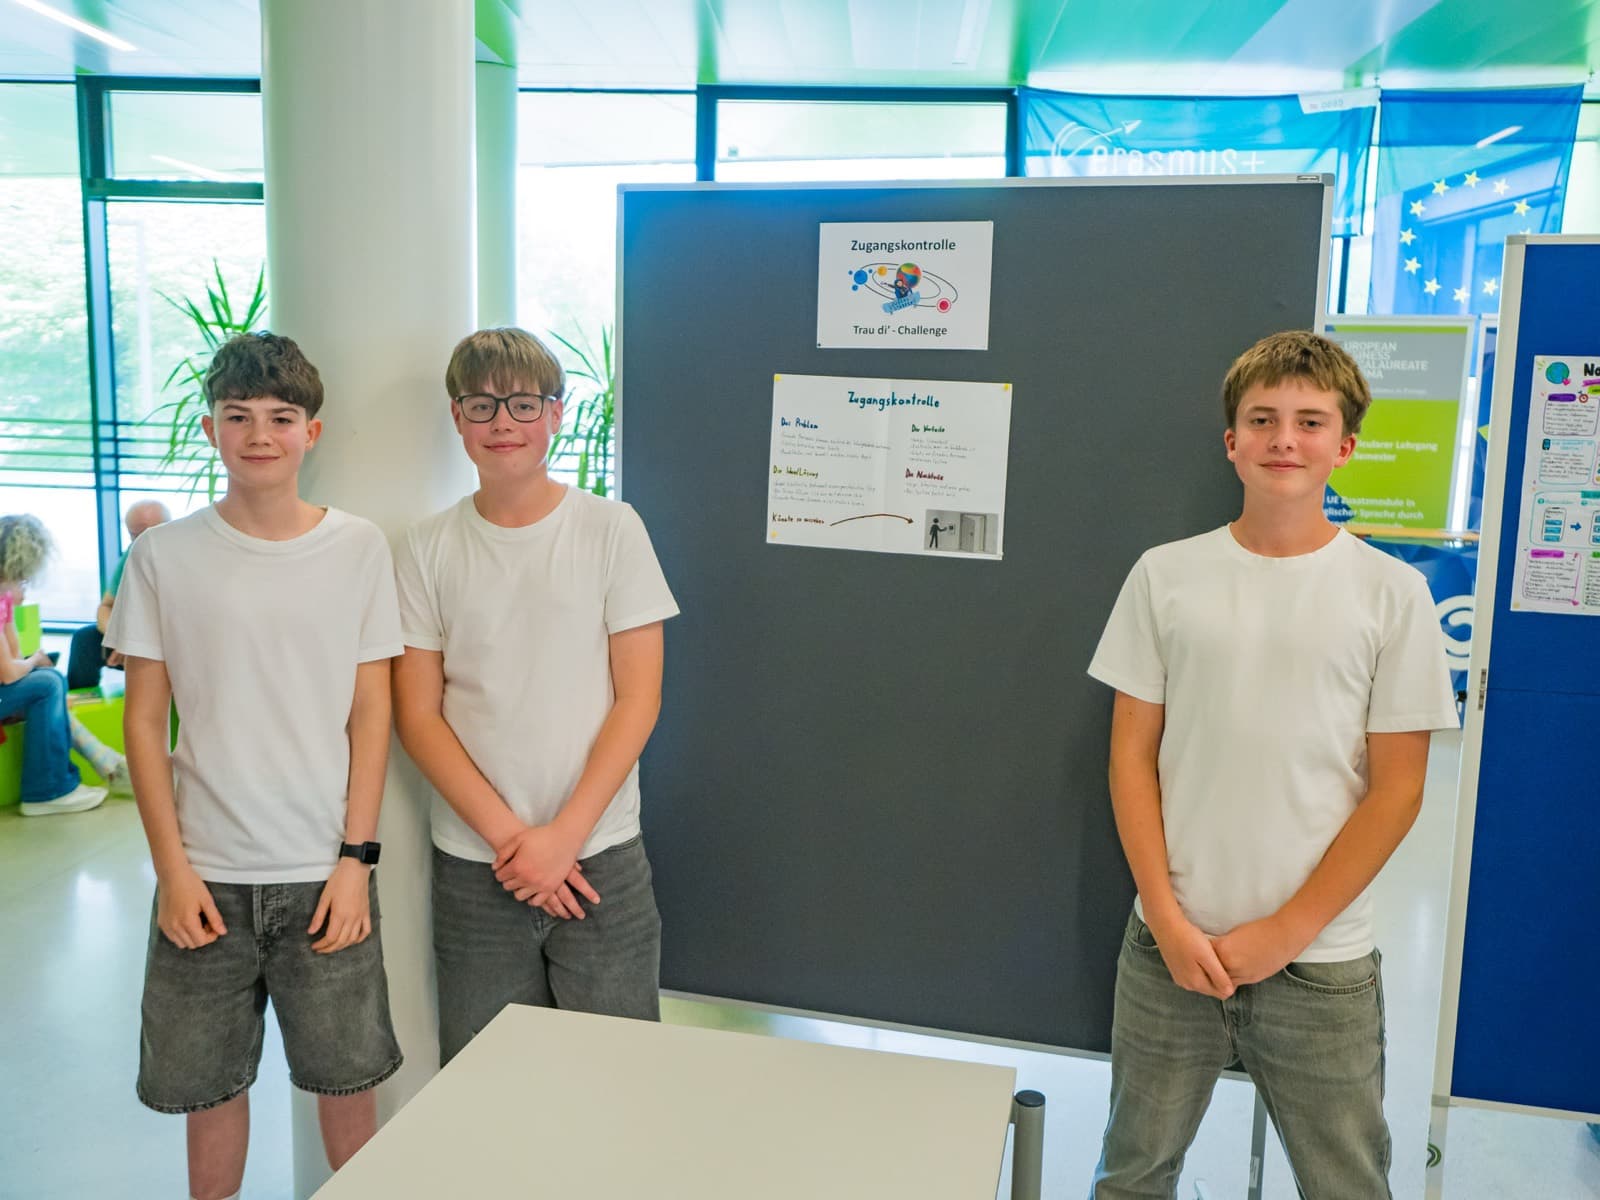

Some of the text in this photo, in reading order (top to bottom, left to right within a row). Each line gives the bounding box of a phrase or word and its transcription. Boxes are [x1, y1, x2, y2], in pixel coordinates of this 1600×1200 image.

[851, 239, 956, 253] Zugangskontrolle
[853, 326, 875, 335] Trau
[898, 326, 948, 337] Challenge
[1343, 341, 1397, 352] UROPEAN
[848, 391, 940, 411] Zugangskontrolle
[795, 417, 819, 429] Problem
